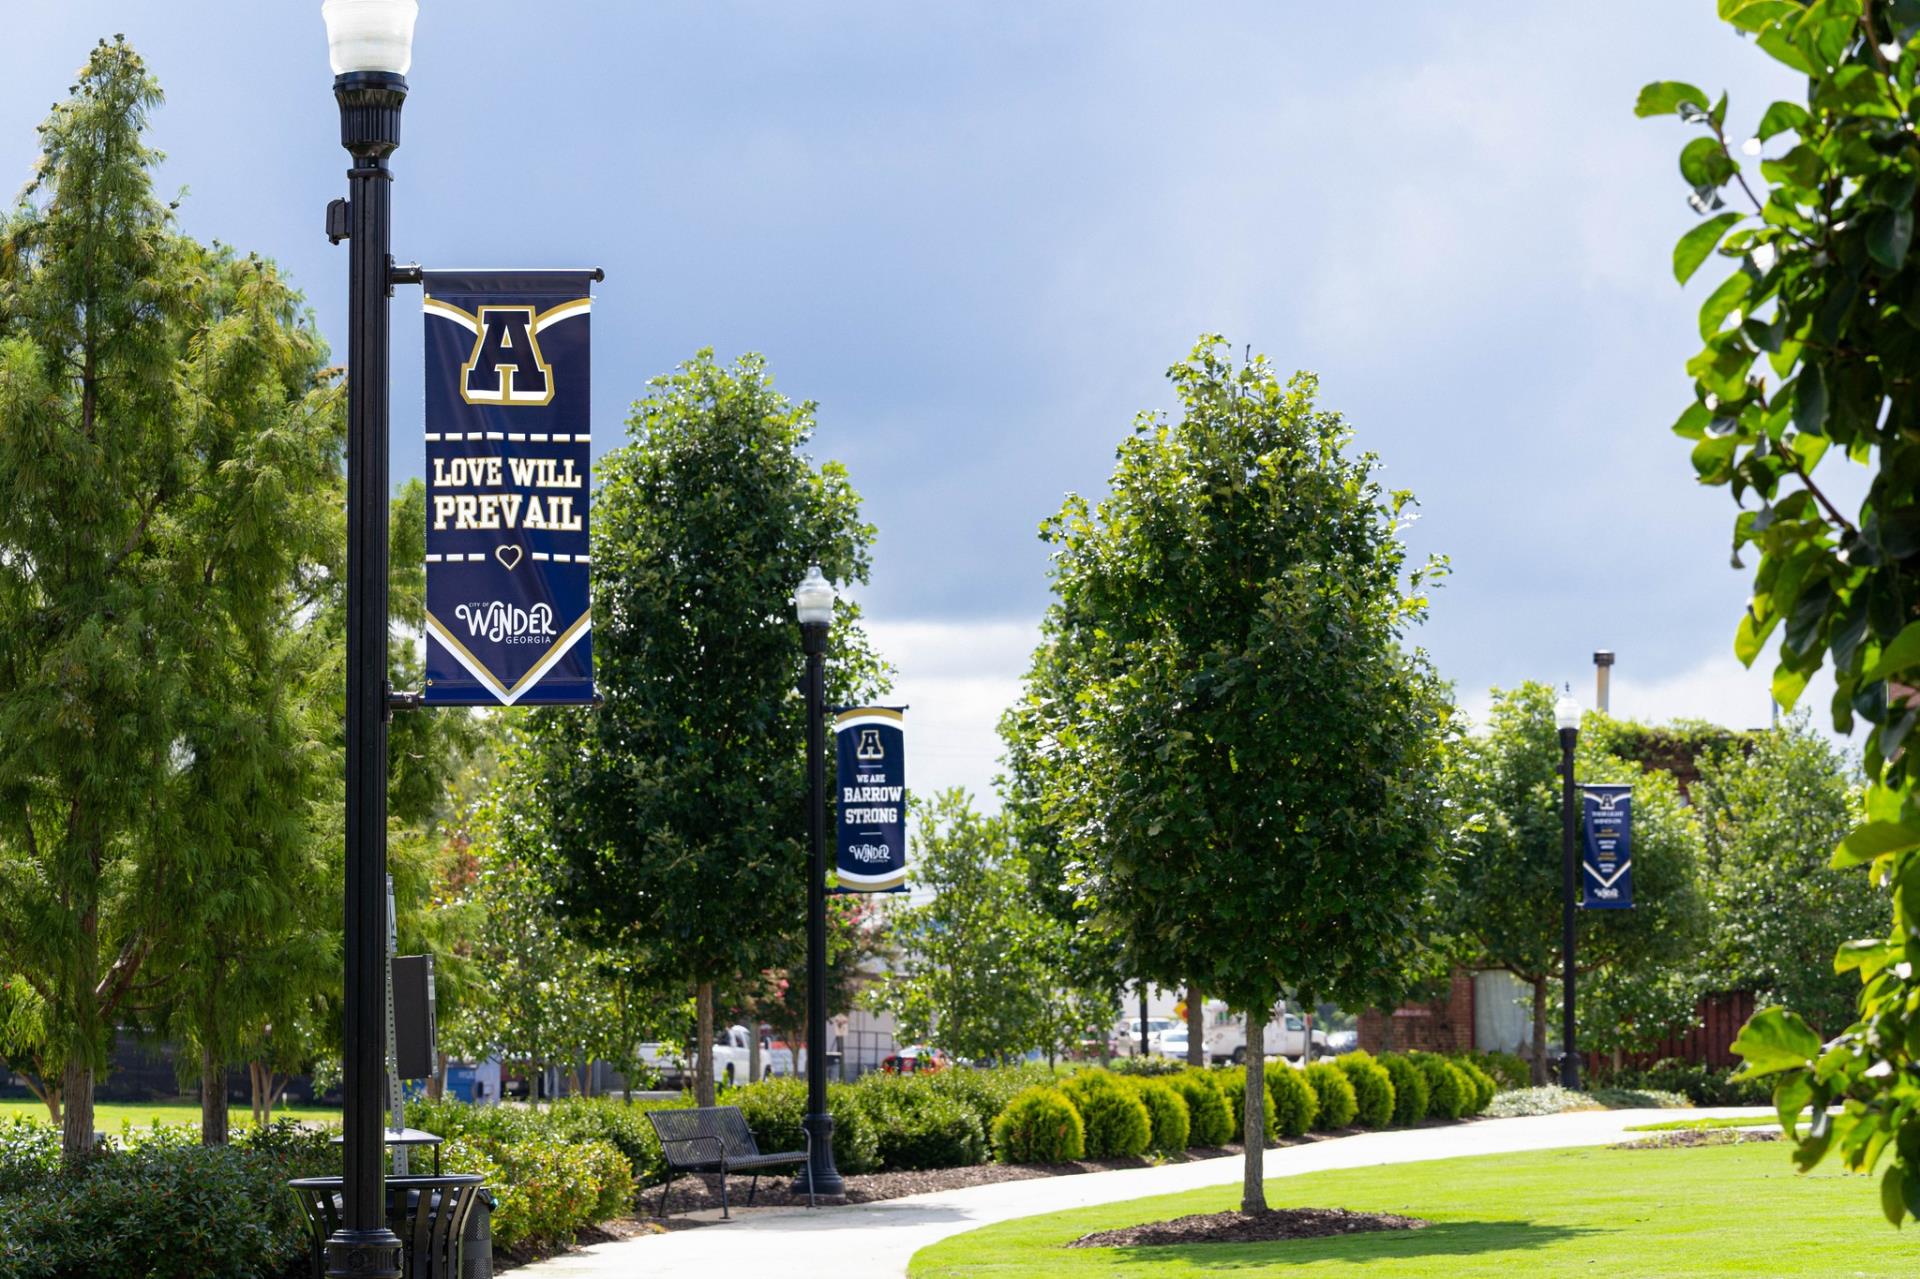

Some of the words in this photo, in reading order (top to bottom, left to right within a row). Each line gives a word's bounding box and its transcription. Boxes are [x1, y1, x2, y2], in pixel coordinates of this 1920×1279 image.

[460, 305, 555, 406] A
[433, 457, 502, 487] LOVE
[508, 457, 582, 488] WILL
[433, 494, 583, 531] PREVAIL
[455, 601, 557, 643] WINDER
[505, 635, 551, 644] GEORGIA
[857, 730, 884, 759] A
[856, 774, 869, 783] WE
[869, 774, 886, 783] ARE
[843, 786, 903, 802] BARROW
[845, 808, 898, 824] STRONG
